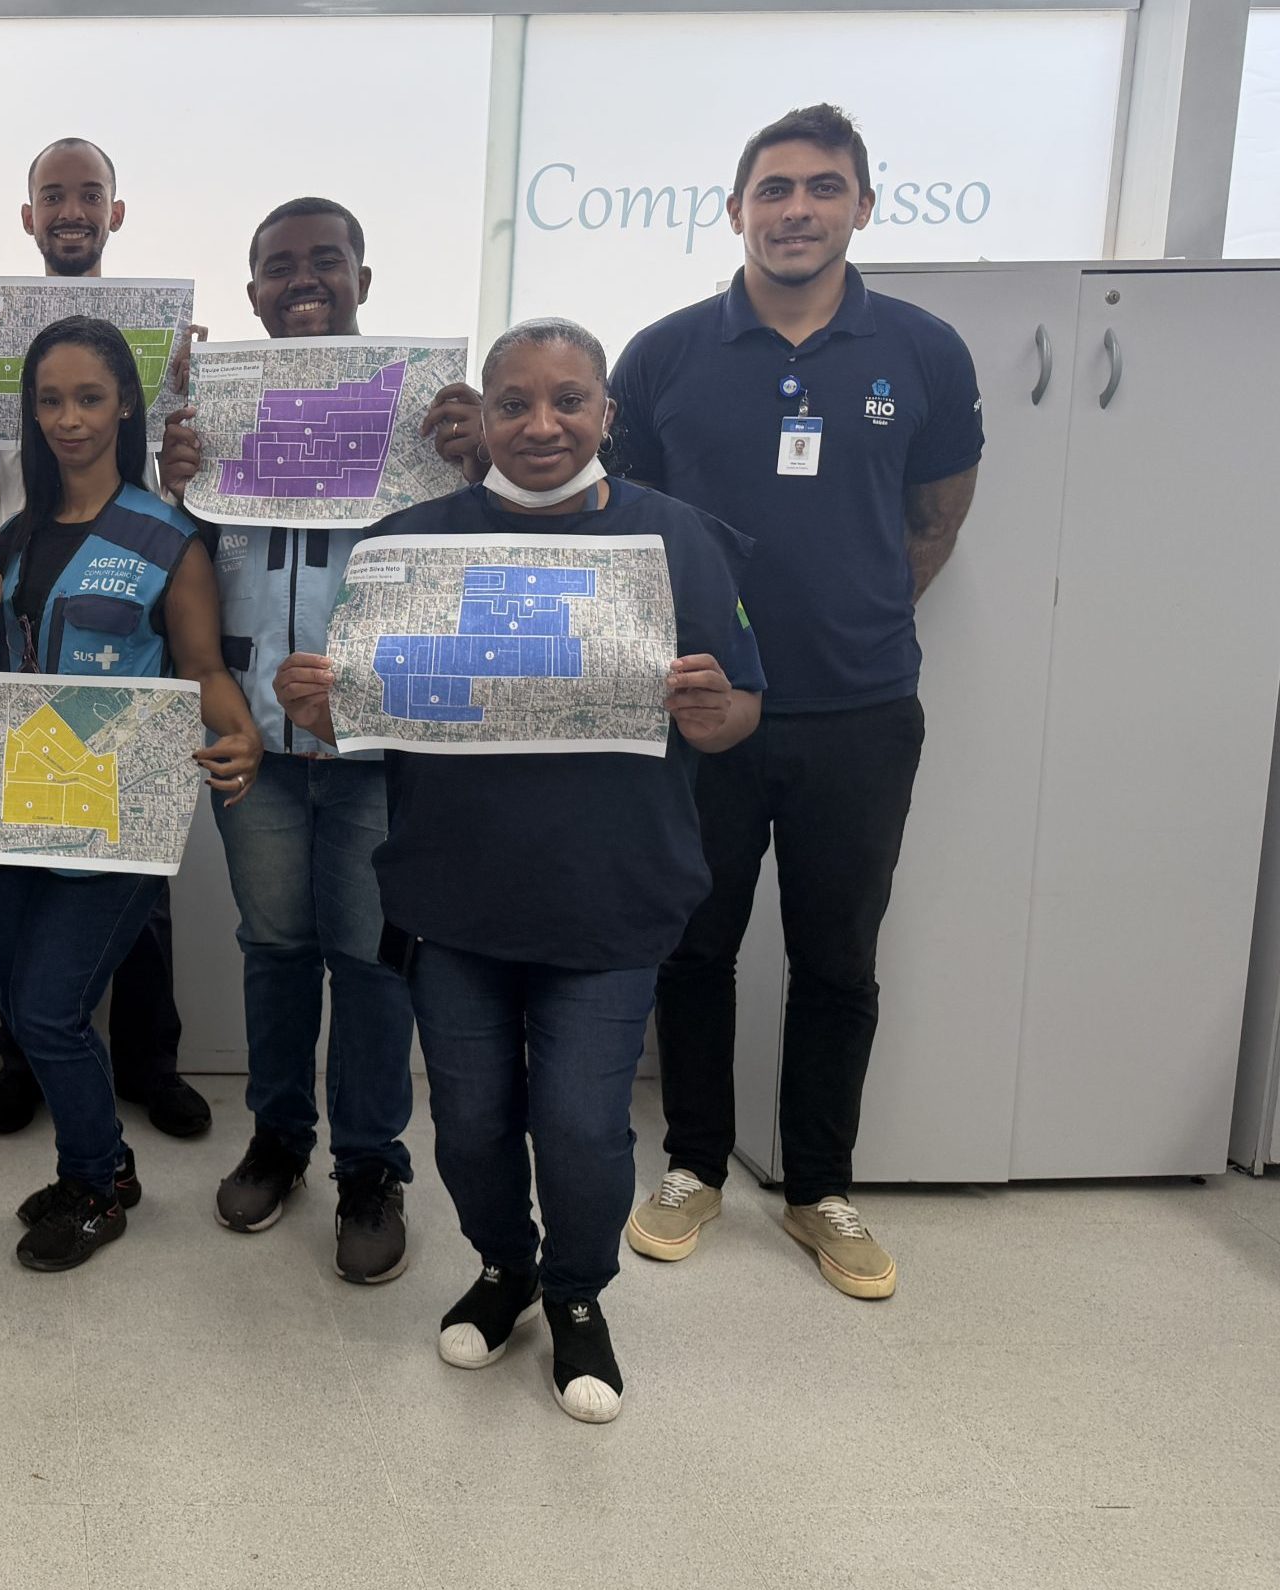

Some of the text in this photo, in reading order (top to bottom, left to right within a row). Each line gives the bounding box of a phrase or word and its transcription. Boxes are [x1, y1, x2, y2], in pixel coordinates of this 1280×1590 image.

[526, 161, 991, 254] Compisso
[865, 400, 895, 416] RIO
[222, 534, 249, 550] Rio
[88, 557, 148, 574] AGENTE
[79, 577, 138, 597] SAÚDE
[72, 650, 95, 662] SUS
